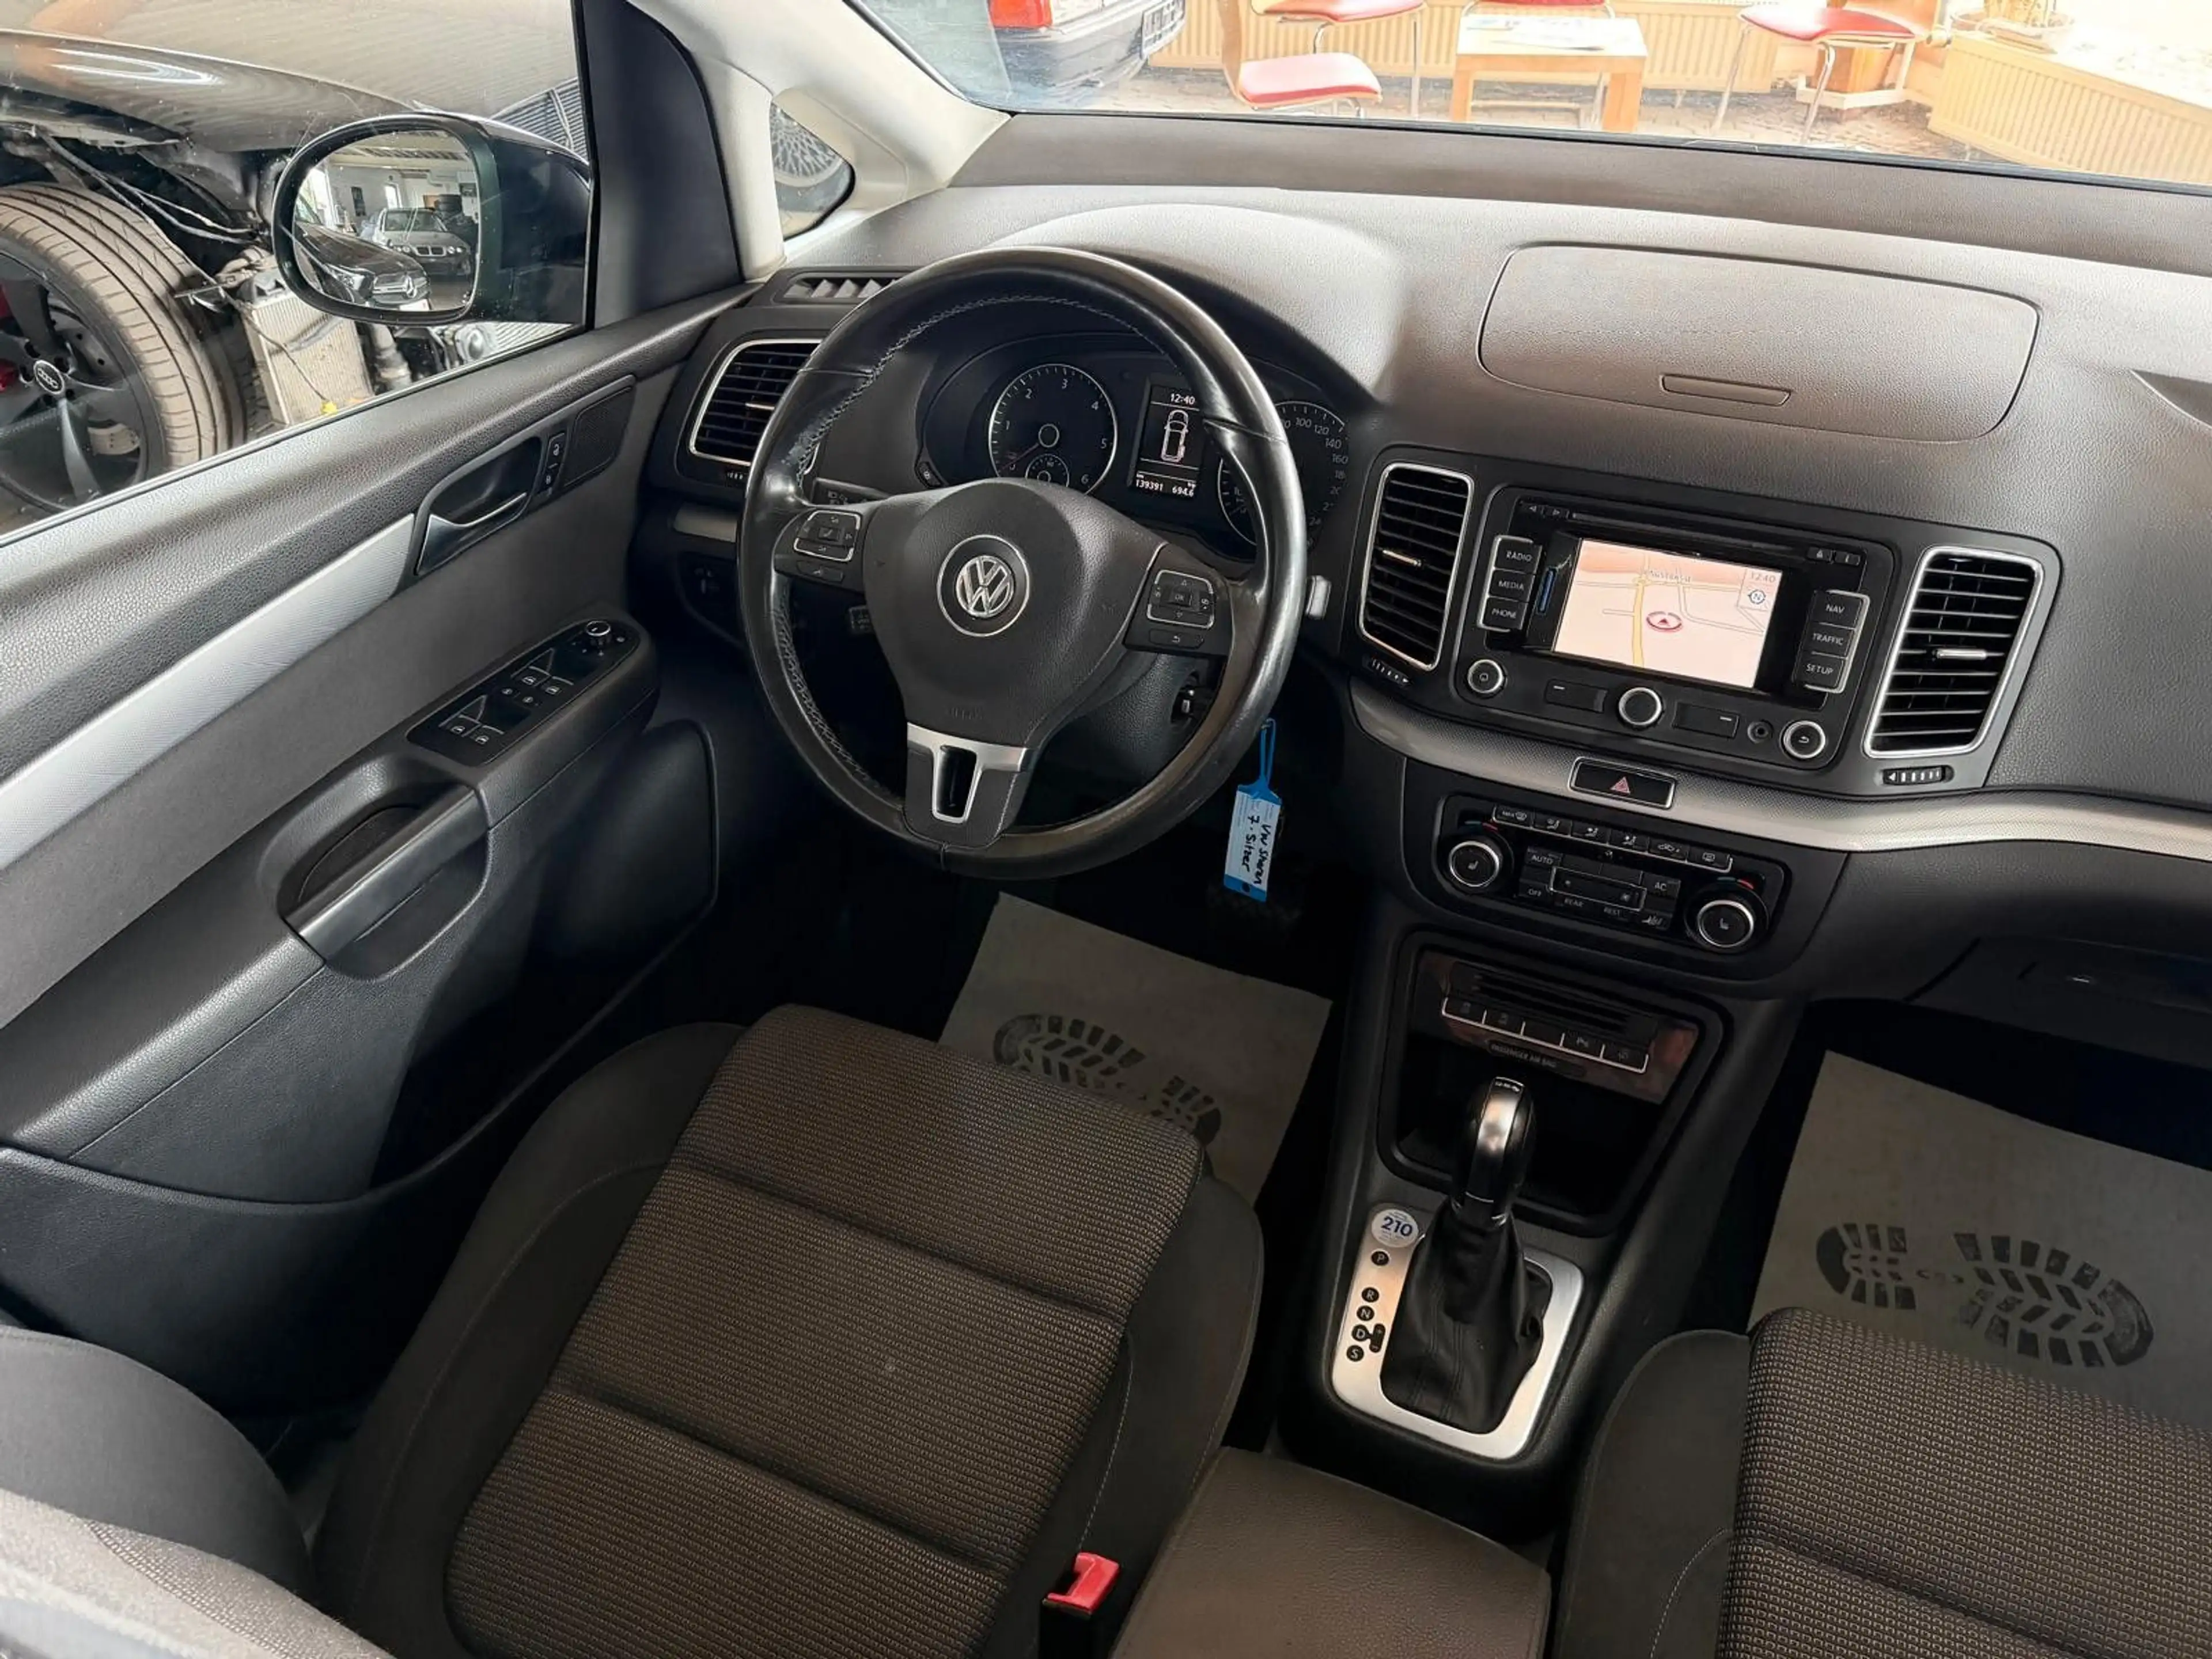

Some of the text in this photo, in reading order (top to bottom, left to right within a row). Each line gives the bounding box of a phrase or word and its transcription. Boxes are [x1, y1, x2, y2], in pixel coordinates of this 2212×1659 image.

[1061, 378, 1069, 389] 3
[1025, 388, 1033, 399] 2
[1171, 393, 1195, 405] 12:40
[1091, 401, 1099, 410] 4
[1296, 417, 1312, 429] 100
[1315, 425, 1330, 435] 120
[1101, 438, 1107, 449] 5
[1325, 438, 1342, 449] 140
[1081, 474, 1089, 484] 6
[1506, 550, 1533, 563] RADIO
[1498, 579, 1525, 590] MEDIA
[1491, 608, 1517, 619] PHONE
[1825, 604, 1845, 614] NAV
[1813, 632, 1844, 646] TRAFFIC
[1806, 663, 1834, 675] SETUP
[1260, 824, 1272, 846] VW
[1531, 854, 1554, 865] AUTO
[1654, 881, 1667, 891] AC
[1528, 888, 1542, 897] OFF
[1381, 1215, 1413, 1237] 210
[1377, 1254, 1385, 1263] P
[1367, 1290, 1374, 1300] R
[1361, 1308, 1371, 1318] N
[1356, 1329, 1365, 1339] D
[1351, 1349, 1360, 1359] S
